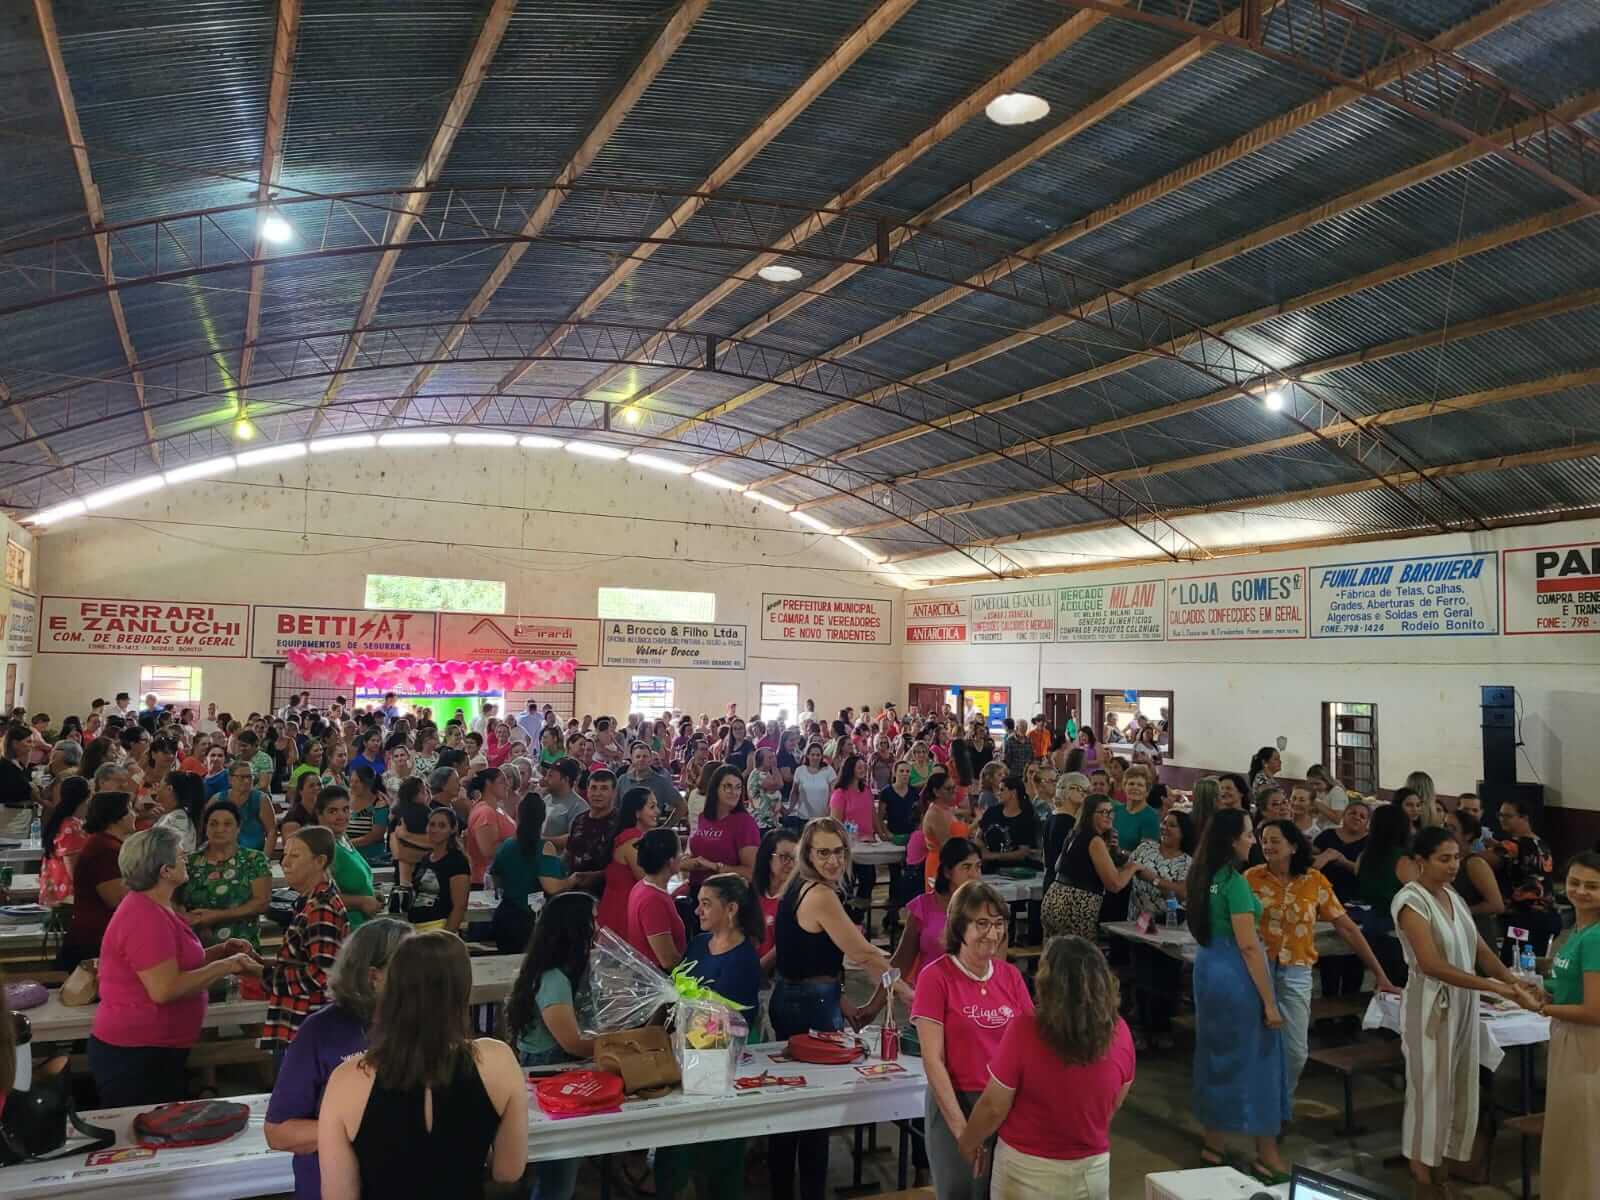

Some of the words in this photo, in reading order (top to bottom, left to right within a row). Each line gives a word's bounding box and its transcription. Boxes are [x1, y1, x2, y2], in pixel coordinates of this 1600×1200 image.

[1320, 565, 1394, 589] FUNILARIA
[1400, 558, 1484, 583] BARIVIERA
[1060, 587, 1104, 600] MERCADO
[1108, 584, 1156, 609] MILANI
[1180, 582, 1218, 605] LOJA
[1231, 576, 1291, 602] GOMES
[1379, 587, 1392, 597] de
[783, 600, 833, 613] PREFEITURA
[834, 602, 876, 614] MUNICIPAL
[912, 602, 960, 617] ANTARCTICA
[1367, 599, 1415, 609] Aberturas
[1419, 597, 1432, 607] de
[1562, 605, 1569, 615] E
[80, 602, 214, 621] FERRARI
[1259, 606, 1271, 621] EM
[1275, 605, 1302, 621] GERAL
[1327, 612, 1372, 624] Algerosas
[1385, 609, 1418, 620] Soldas
[1422, 610, 1439, 619] em
[1443, 607, 1473, 618] Geral
[49, 616, 67, 630] E
[83, 617, 240, 636] ZANLUCHI
[770, 612, 777, 623] E
[813, 614, 825, 625] DE
[828, 615, 881, 628] VEREADORES
[1401, 620, 1440, 631] Rodeio
[1446, 619, 1485, 630] Bonito
[626, 624, 666, 636] Brocco
[670, 626, 679, 637] &
[682, 626, 709, 638] Filho
[713, 627, 738, 639] Ltda
[783, 627, 796, 638] DE
[799, 628, 822, 639] NOVO
[912, 627, 960, 640] ANTARCTICA
[53, 632, 85, 642] COM.
[93, 633, 110, 643] DE
[116, 634, 171, 645] BEBIDAS
[175, 635, 193, 645] EM
[199, 636, 236, 646] GERAL
[277, 639, 341, 649] EQUIPAMENTOS
[347, 640, 358, 649] DE
[671, 646, 700, 656] Brocco
